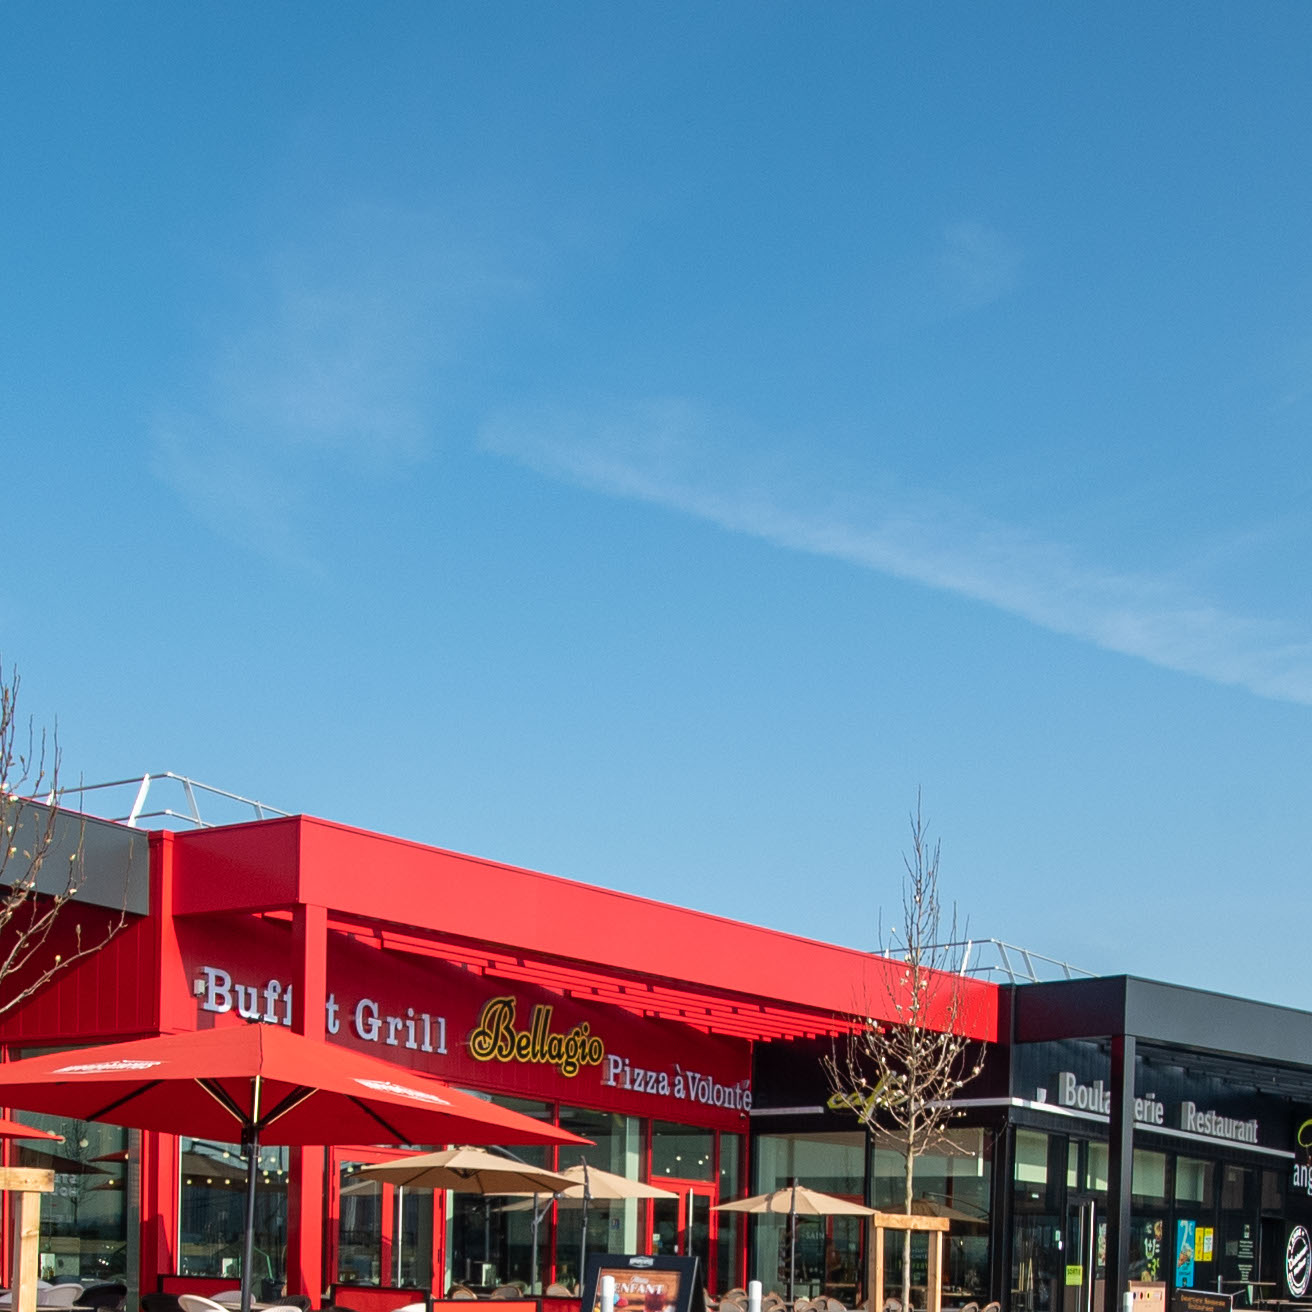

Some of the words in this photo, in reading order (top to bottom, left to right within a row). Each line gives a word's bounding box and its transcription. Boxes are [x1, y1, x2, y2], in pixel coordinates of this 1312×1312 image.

[355, 998, 448, 1055] Grill
[471, 996, 604, 1077] Bellagio
[606, 1054, 670, 1096] Pizza
[674, 1063, 686, 1099] à
[686, 1070, 752, 1112] Volonté
[1182, 1101, 1257, 1144] Restaurant
